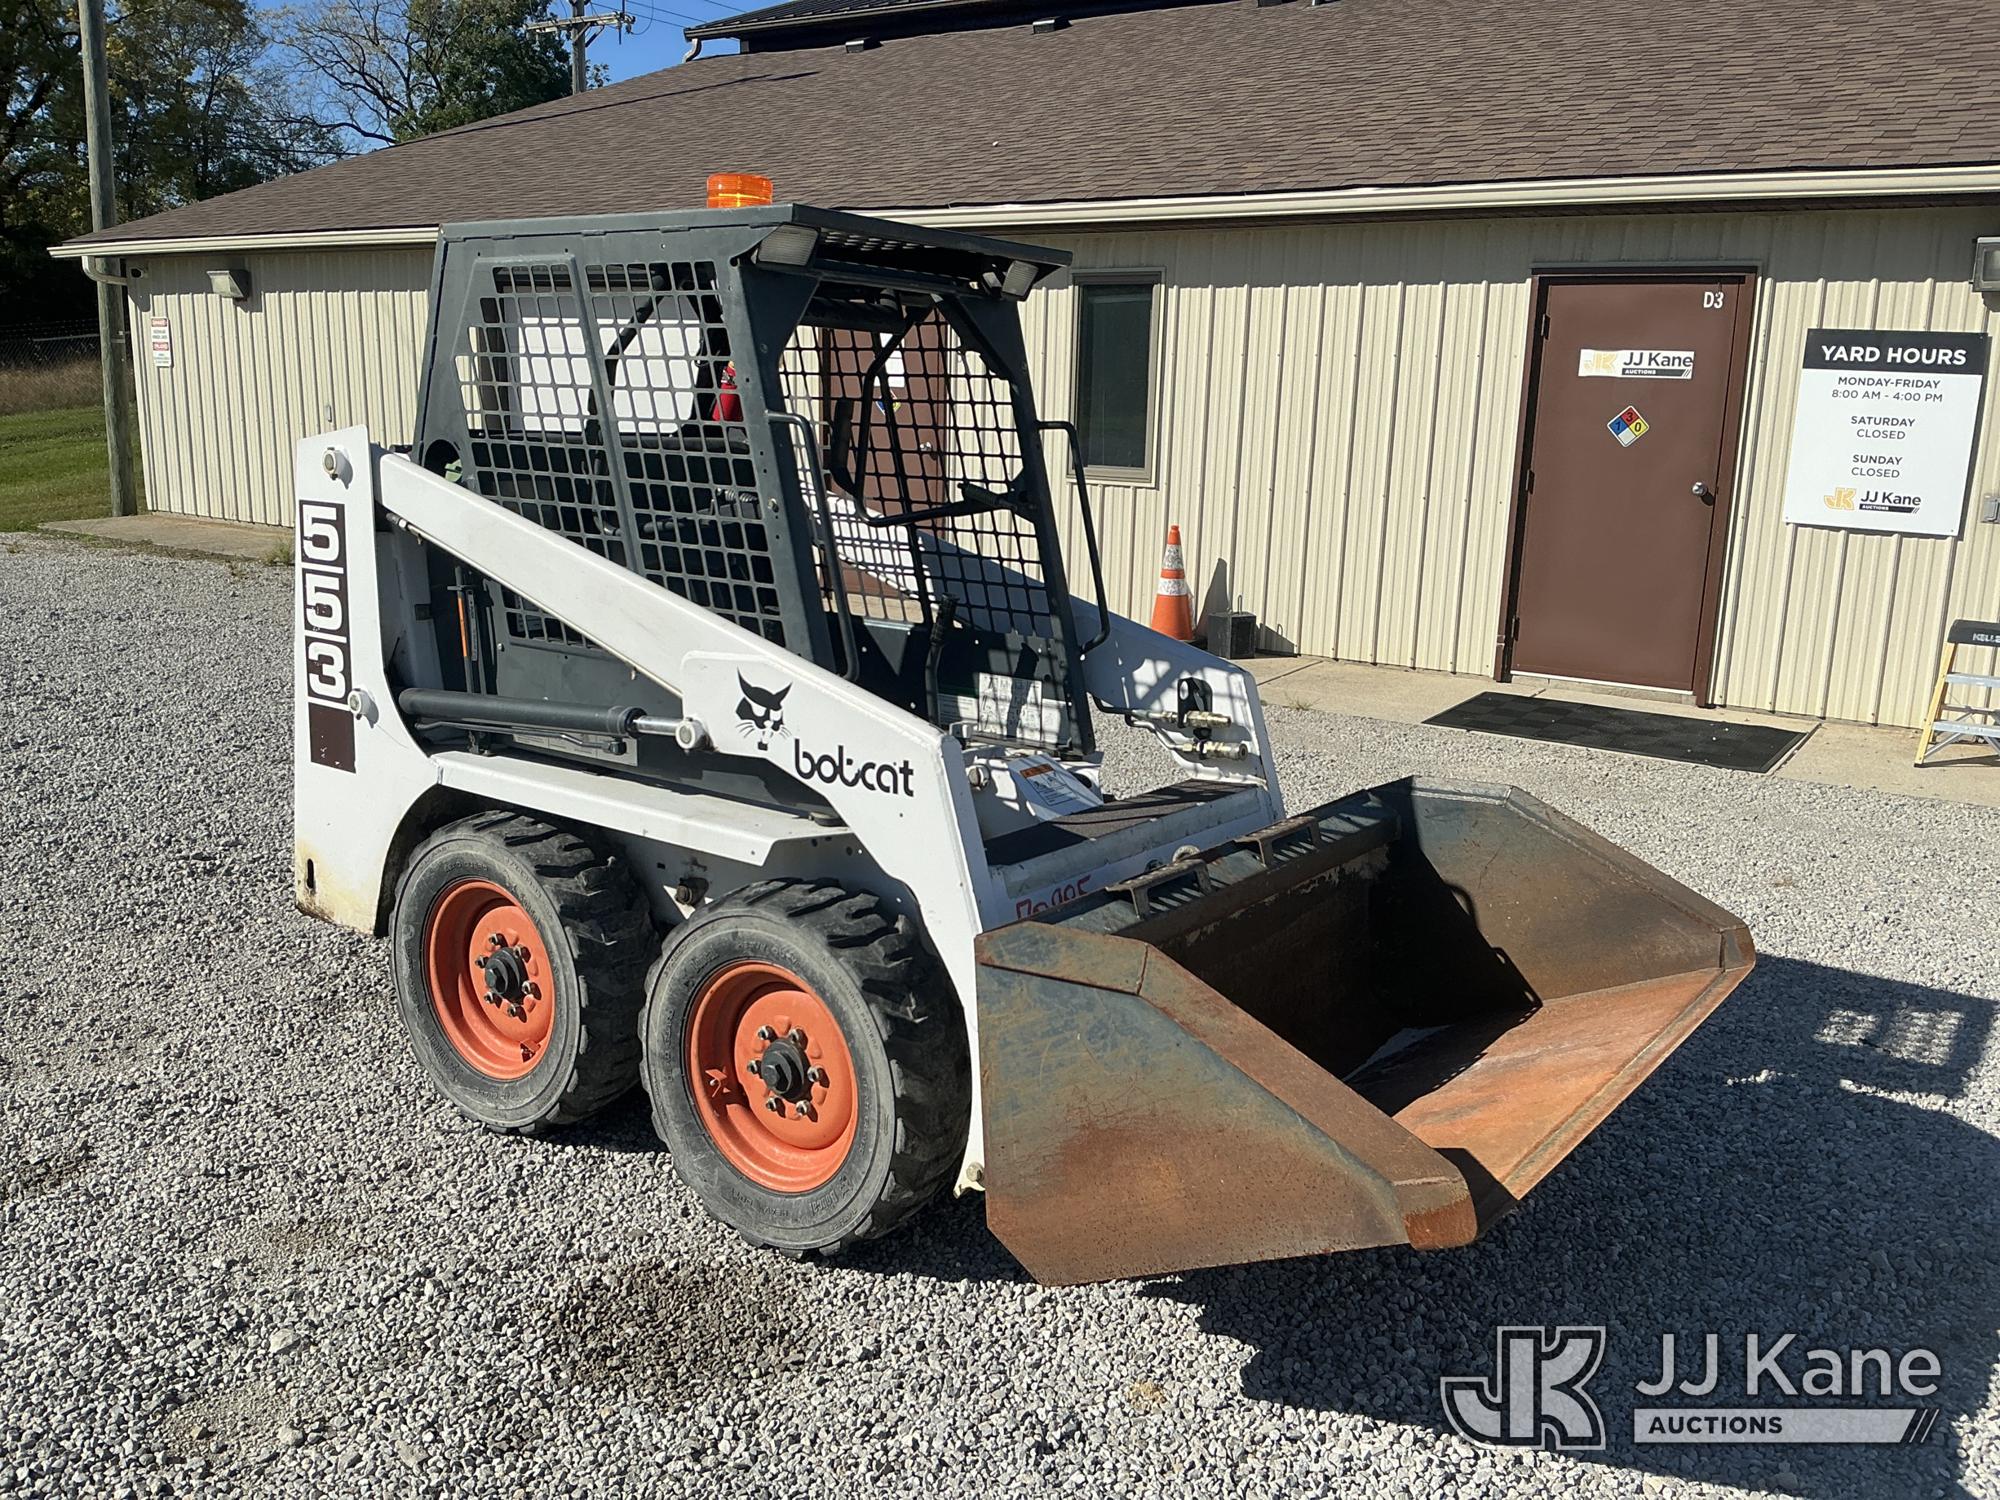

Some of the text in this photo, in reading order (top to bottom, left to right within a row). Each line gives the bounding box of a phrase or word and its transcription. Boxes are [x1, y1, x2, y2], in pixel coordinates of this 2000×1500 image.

[1703, 291, 1724, 309] D3
[1623, 352, 1693, 368] JJ Kane
[1821, 345, 1967, 366] YARD HOURS
[1837, 376, 1941, 389] MONDAY-FRIDAY
[1831, 389, 1859, 399] 8:00
[1862, 390, 1881, 400] AM
[1892, 391, 1920, 402] 4:00
[1925, 393, 1943, 402] PM
[1626, 412, 1634, 422] 3
[1850, 415, 1916, 427] SATURDAY
[1634, 422, 1642, 432] 0
[1856, 428, 1906, 440] CLOSED
[1852, 454, 1903, 465] SUNDAY
[1851, 467, 1900, 478] CLOSED
[1860, 490, 1922, 506] JJ Kane
[302, 503, 346, 699] 553
[794, 738, 914, 797] bobcat
